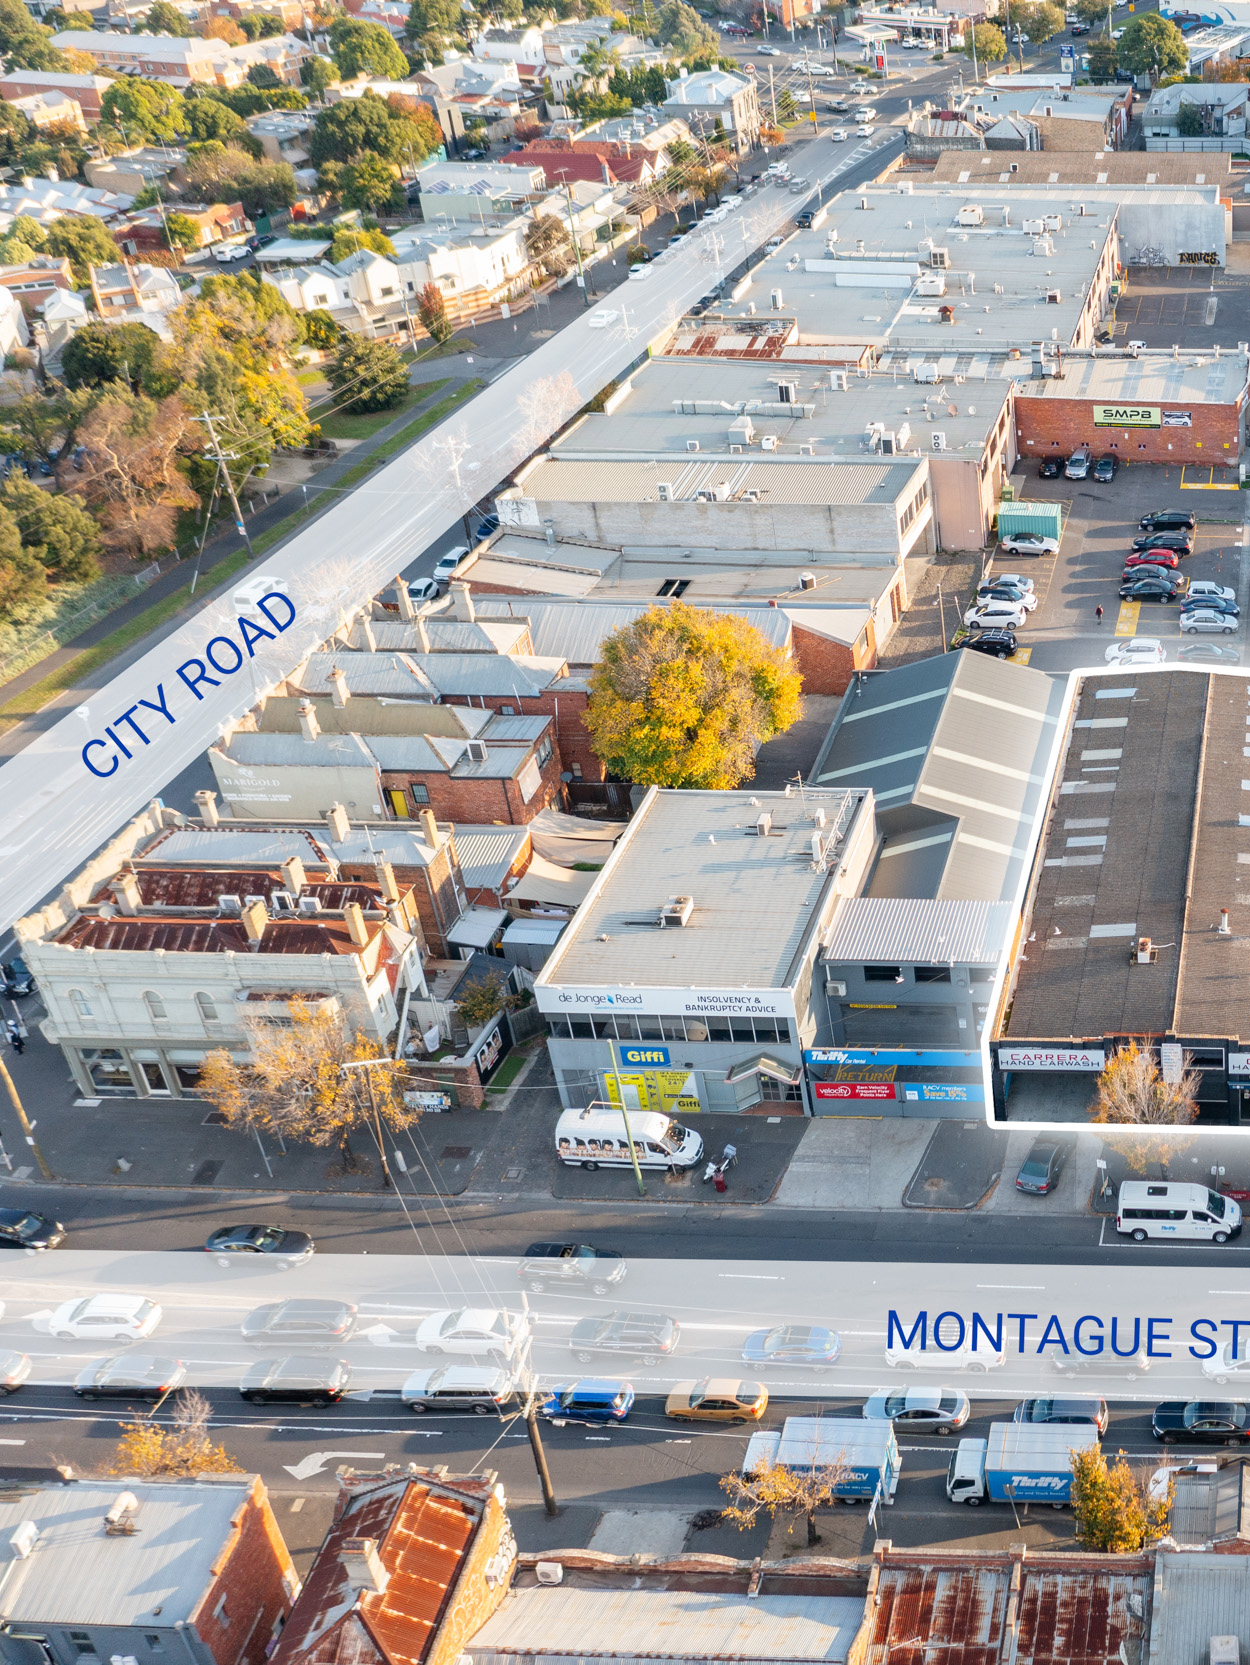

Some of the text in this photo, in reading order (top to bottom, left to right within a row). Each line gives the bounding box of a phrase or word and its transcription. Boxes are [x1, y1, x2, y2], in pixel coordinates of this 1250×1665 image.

[1102, 410, 1152, 418] SMPB
[223, 778, 280, 786] MARIGOLD
[558, 993, 642, 1006] de Jonge Read
[685, 1004, 742, 1012] BANKRUPTCY
[627, 1051, 664, 1062] Giffi
[812, 1051, 848, 1064] Thrifty
[838, 1072, 894, 1082] RETURN
[820, 1086, 848, 1095] velocity
[1012, 1476, 1068, 1490] Thrifty
